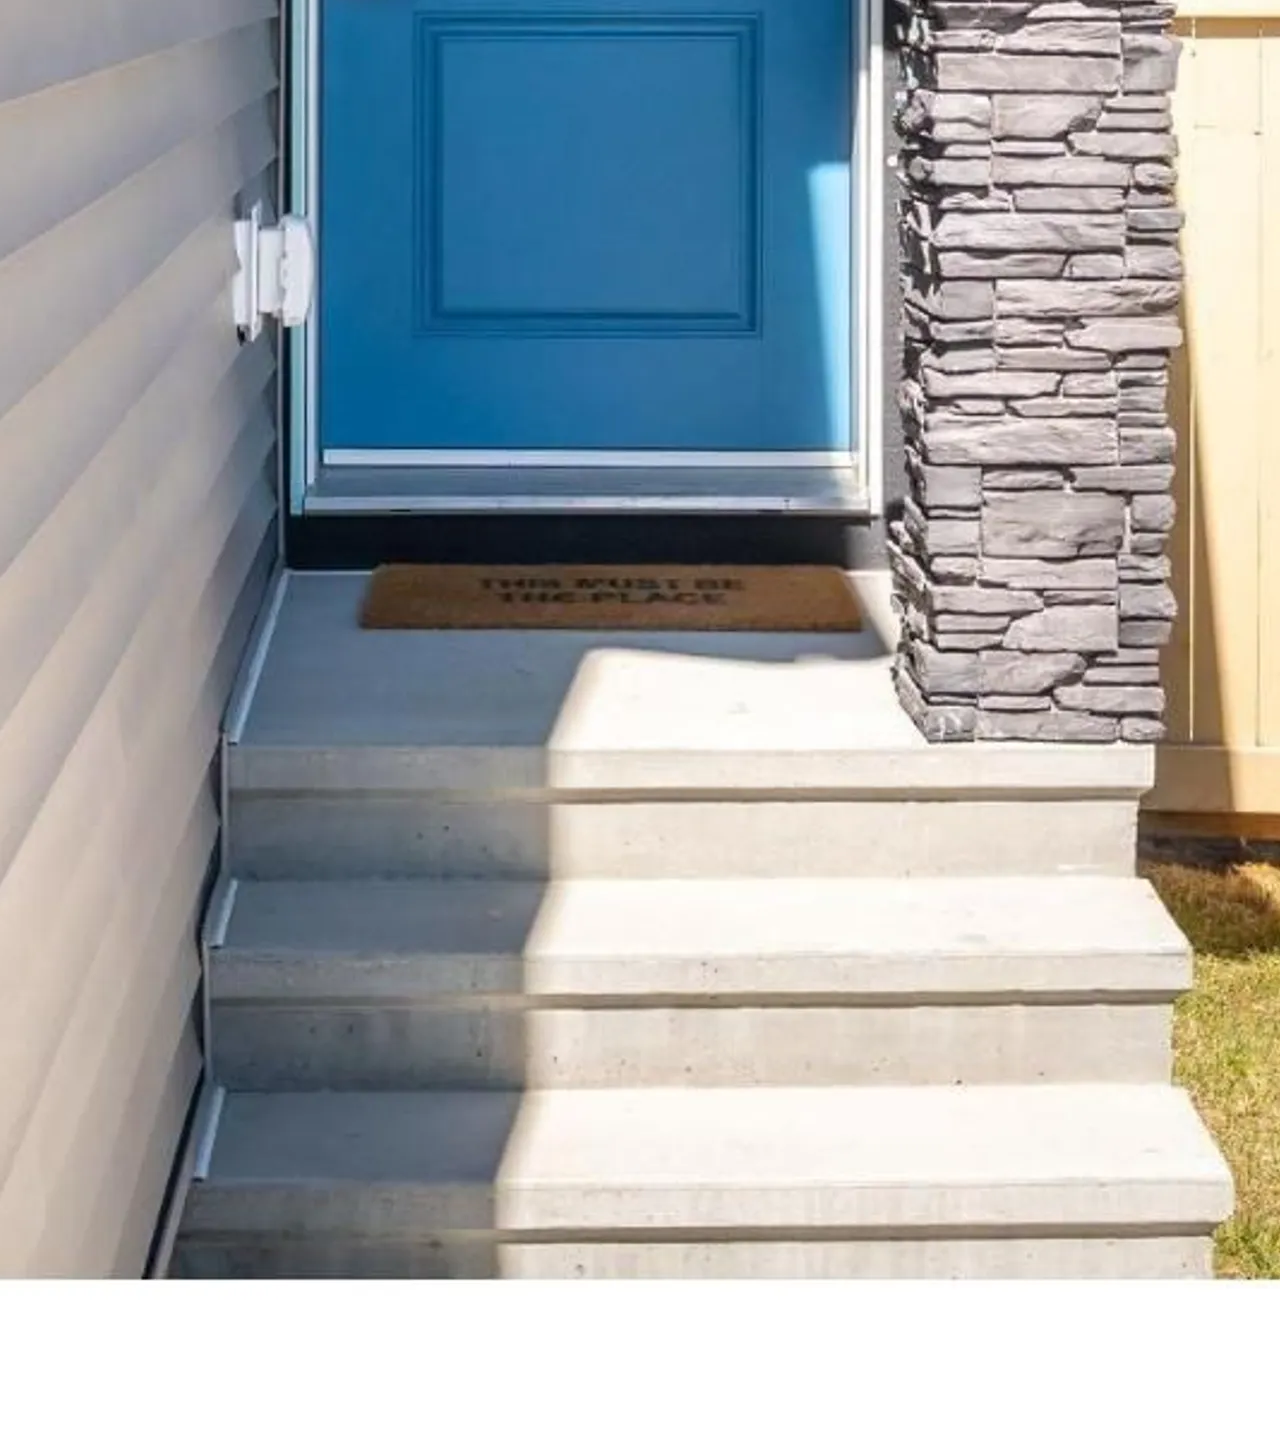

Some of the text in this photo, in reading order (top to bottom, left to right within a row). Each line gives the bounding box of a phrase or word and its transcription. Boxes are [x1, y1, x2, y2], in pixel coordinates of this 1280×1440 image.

[575, 578, 680, 590] MUST
[694, 578, 746, 591] BE
[591, 591, 729, 605] PLACE
